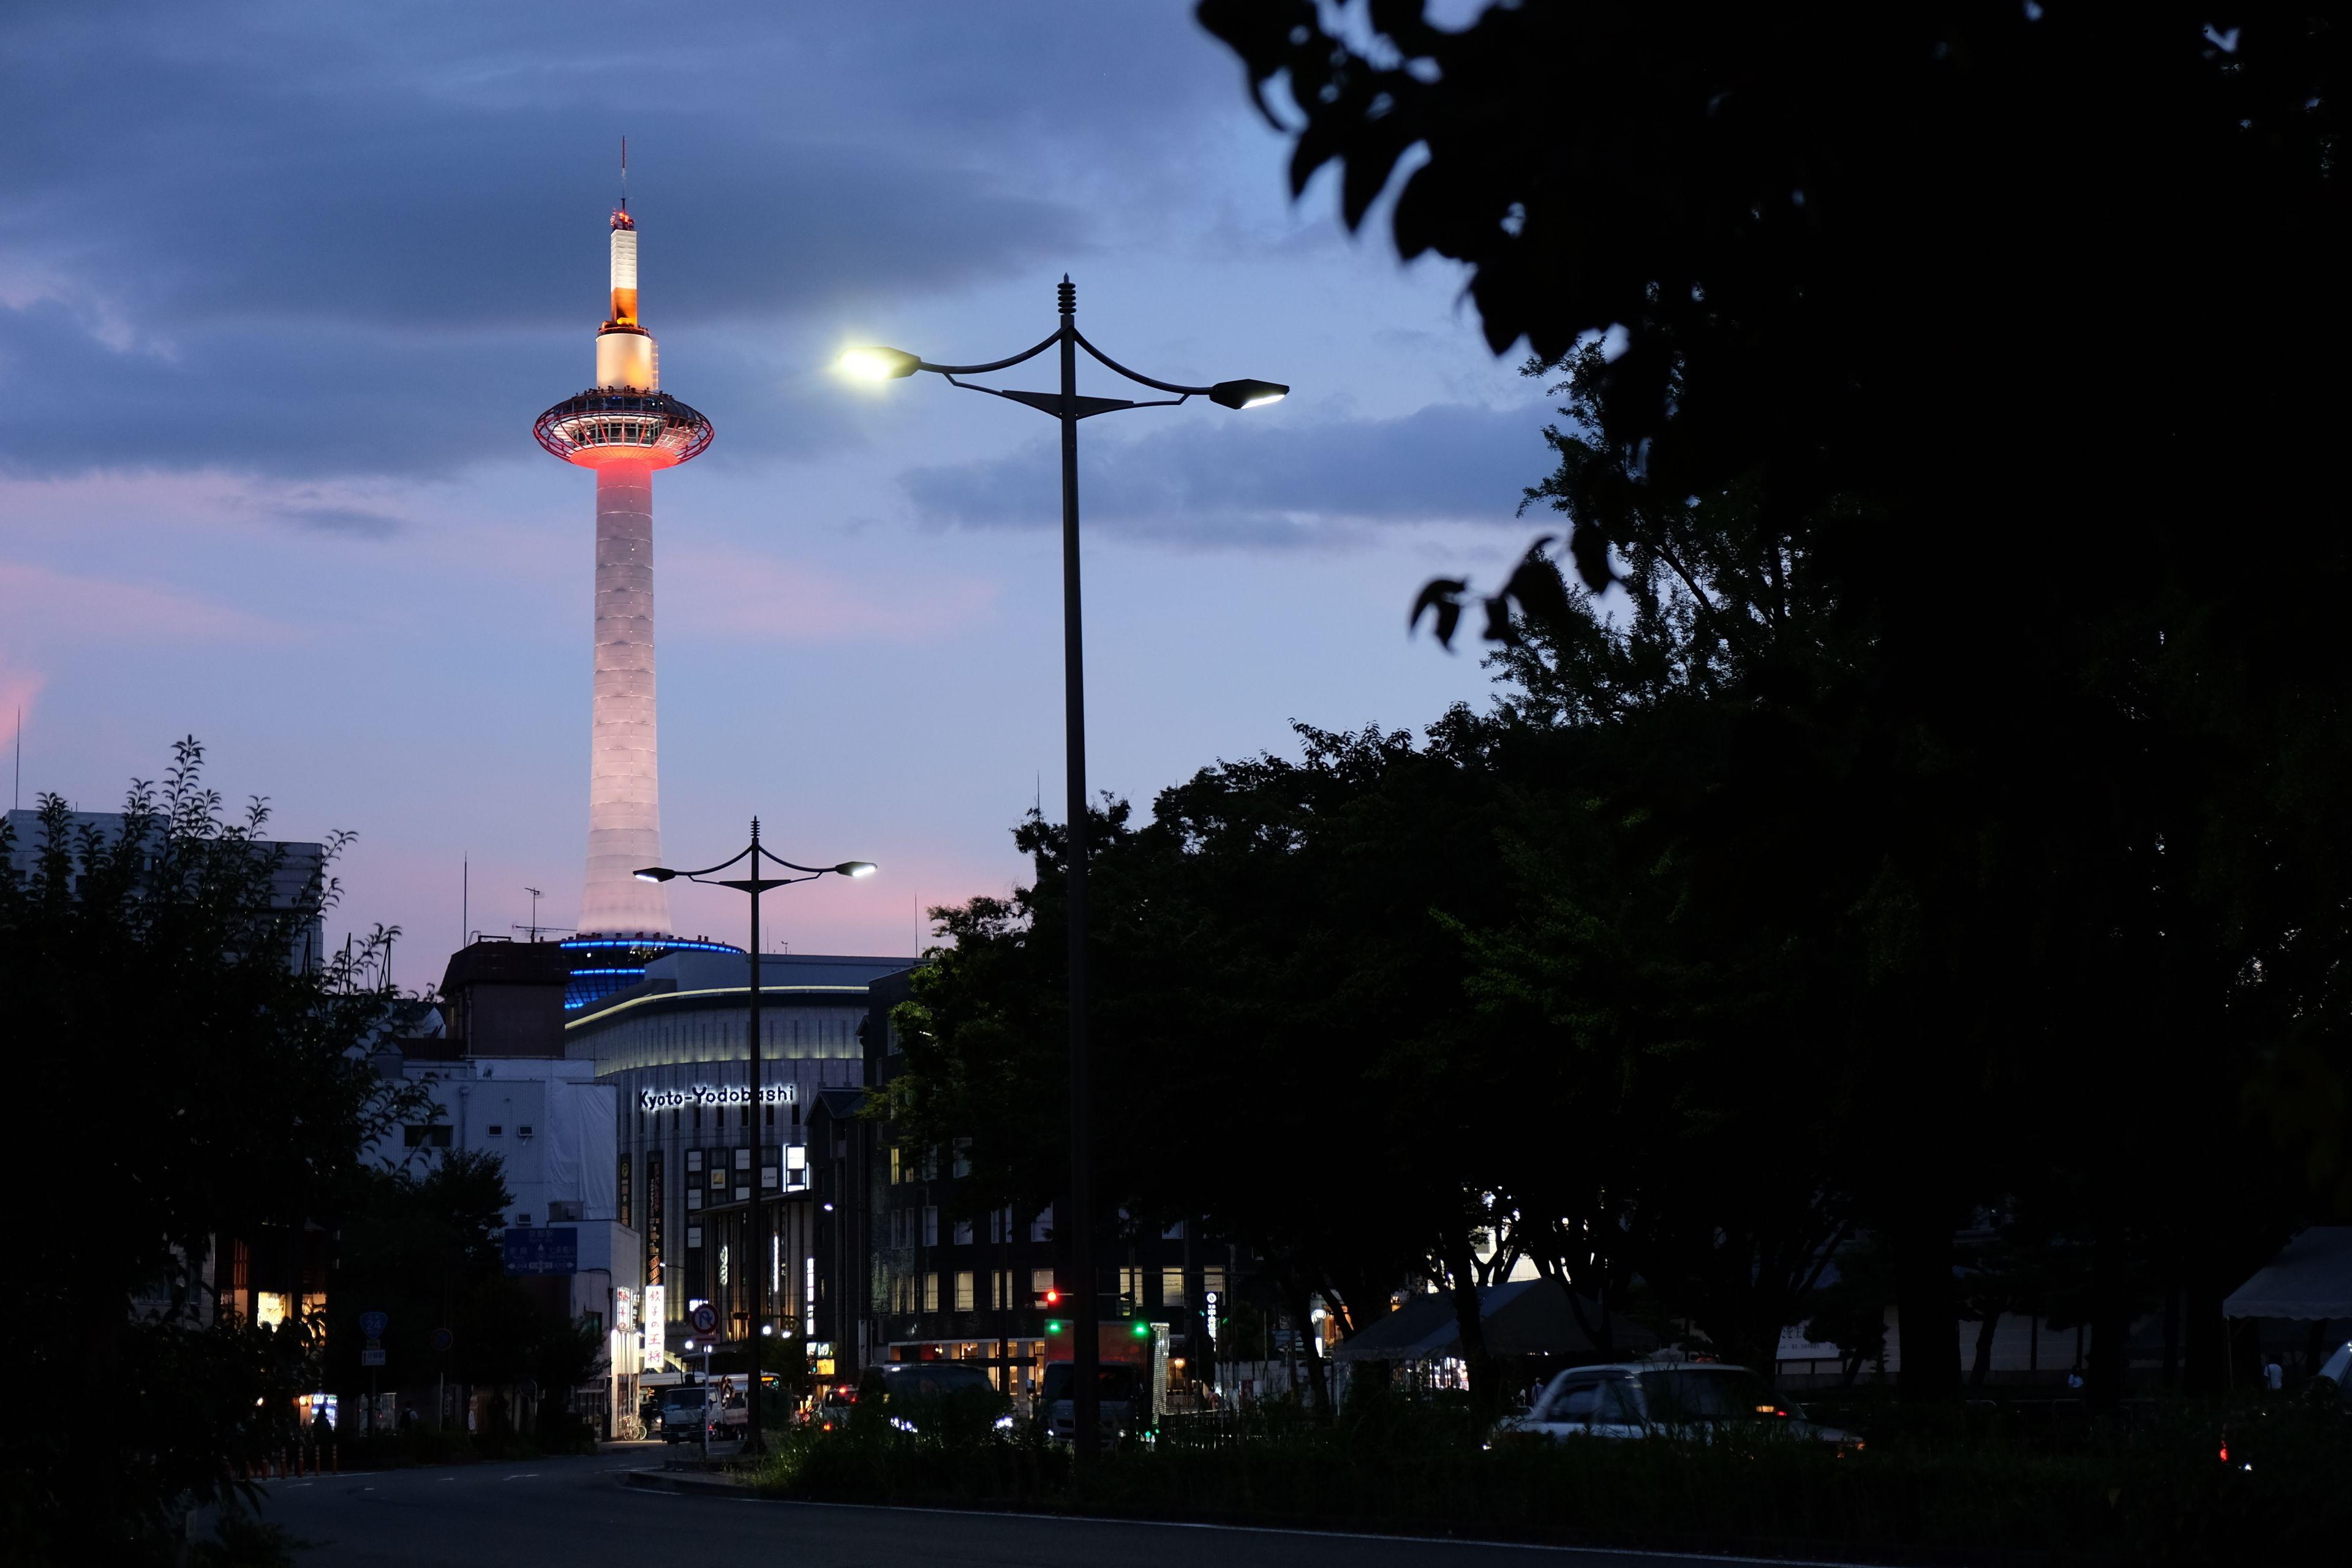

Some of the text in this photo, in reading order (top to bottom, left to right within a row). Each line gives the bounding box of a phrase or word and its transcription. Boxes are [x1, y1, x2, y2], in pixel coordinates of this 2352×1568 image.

[367, 1320, 382, 1330] 24
[648, 1290, 662, 1363] 餃子の王将
